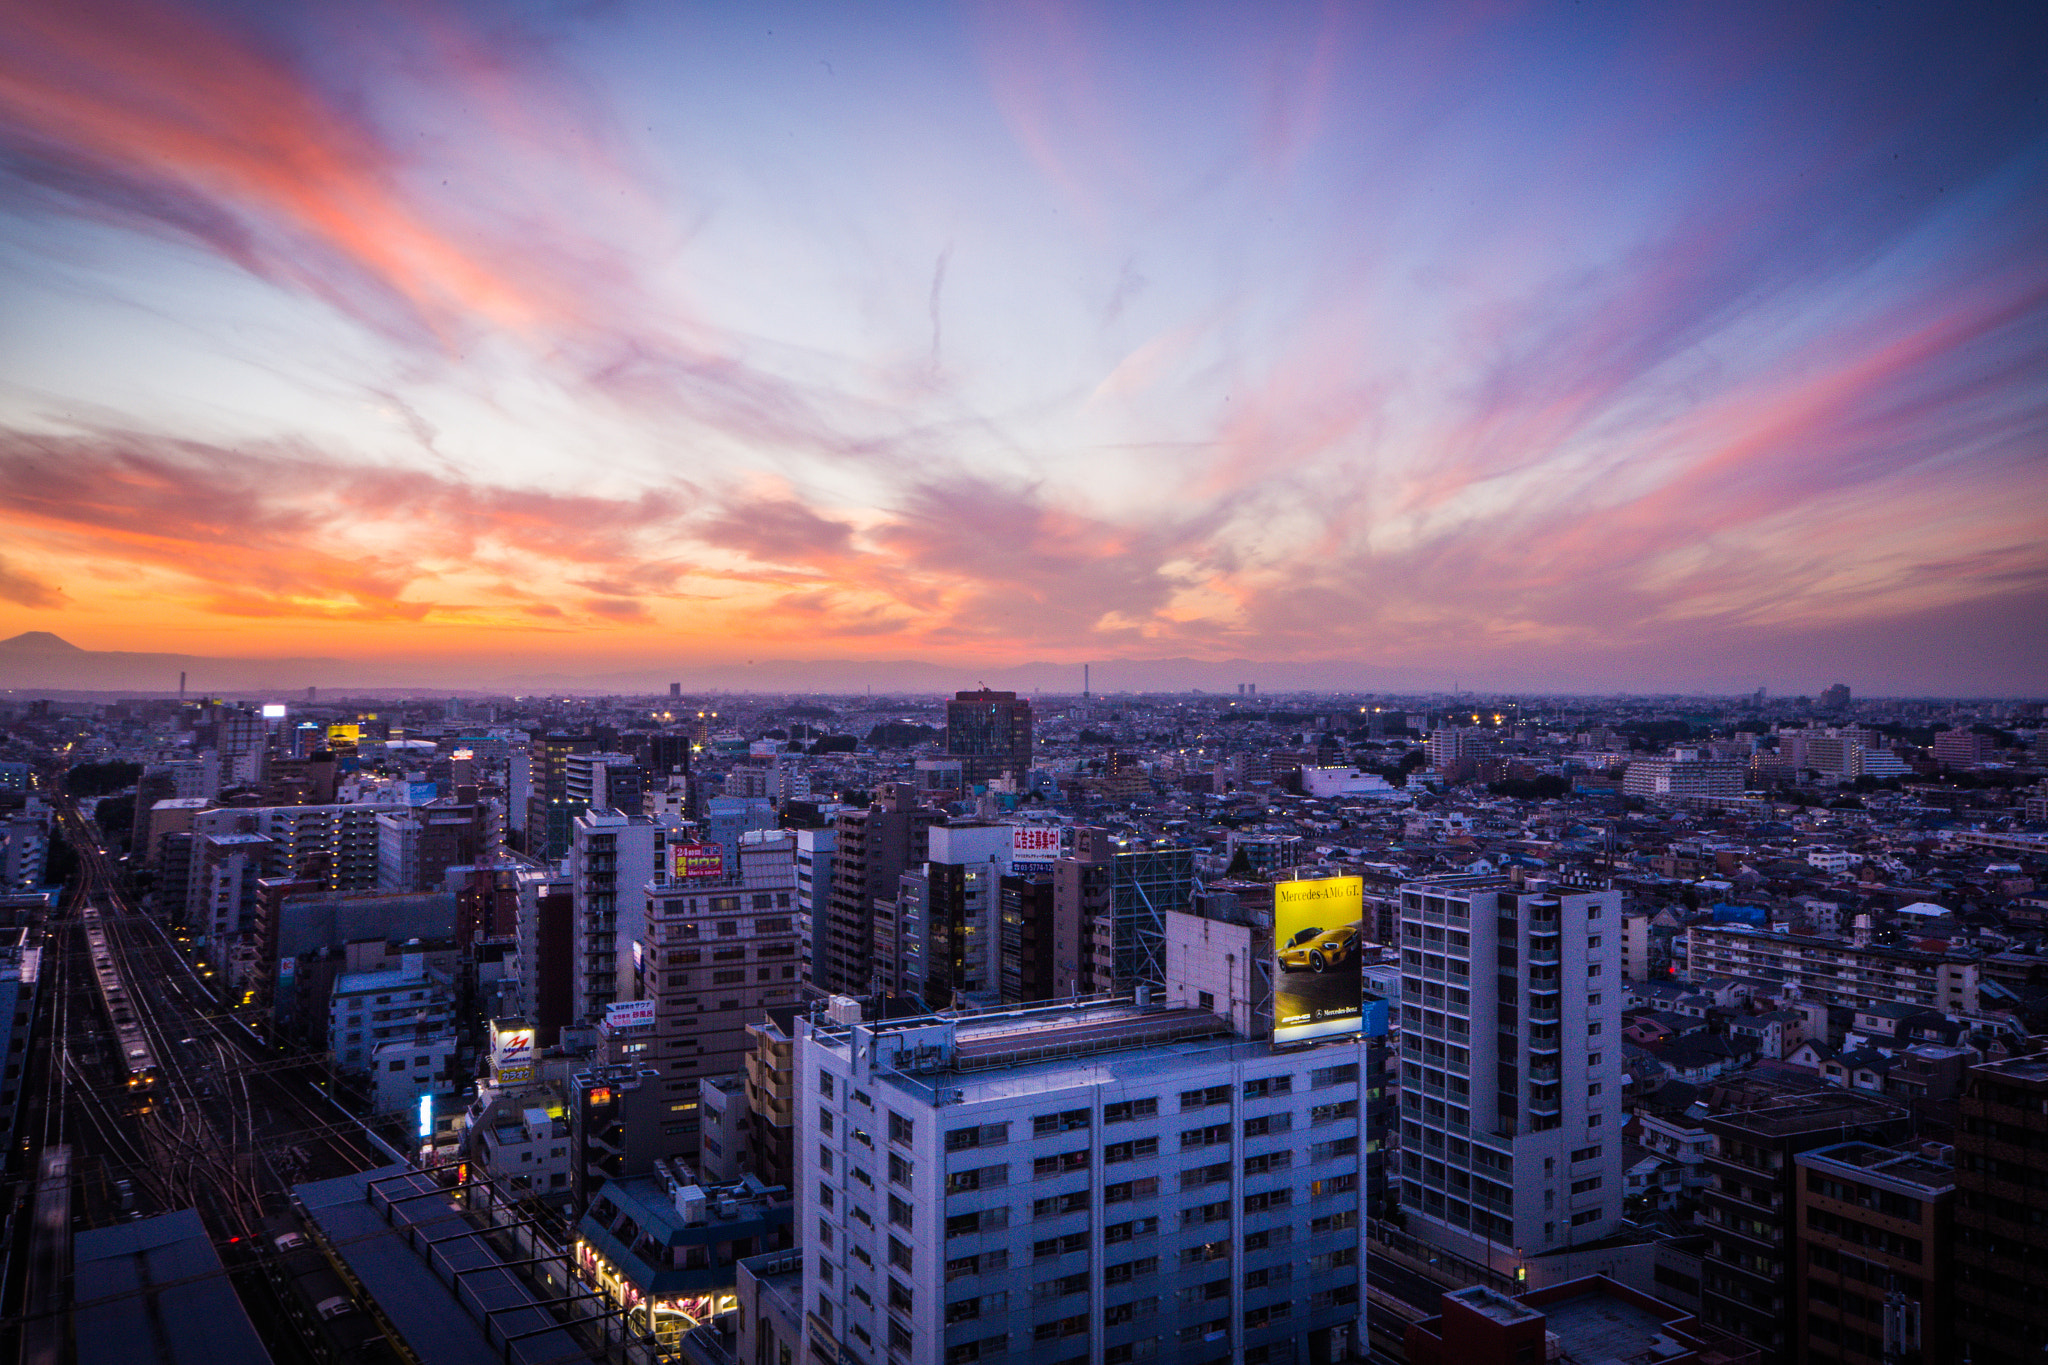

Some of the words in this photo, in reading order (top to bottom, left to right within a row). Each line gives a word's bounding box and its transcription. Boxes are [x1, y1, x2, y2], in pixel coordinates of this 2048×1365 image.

[1014, 830, 1059, 850] 広告主募集中!
[676, 857, 687, 876] 男性
[688, 857, 721, 870] サウナ
[1281, 885, 1344, 903] Mercedes-AMG
[1323, 1006, 1358, 1016] Mercedes-Benz
[502, 1070, 529, 1080] カラオケ
